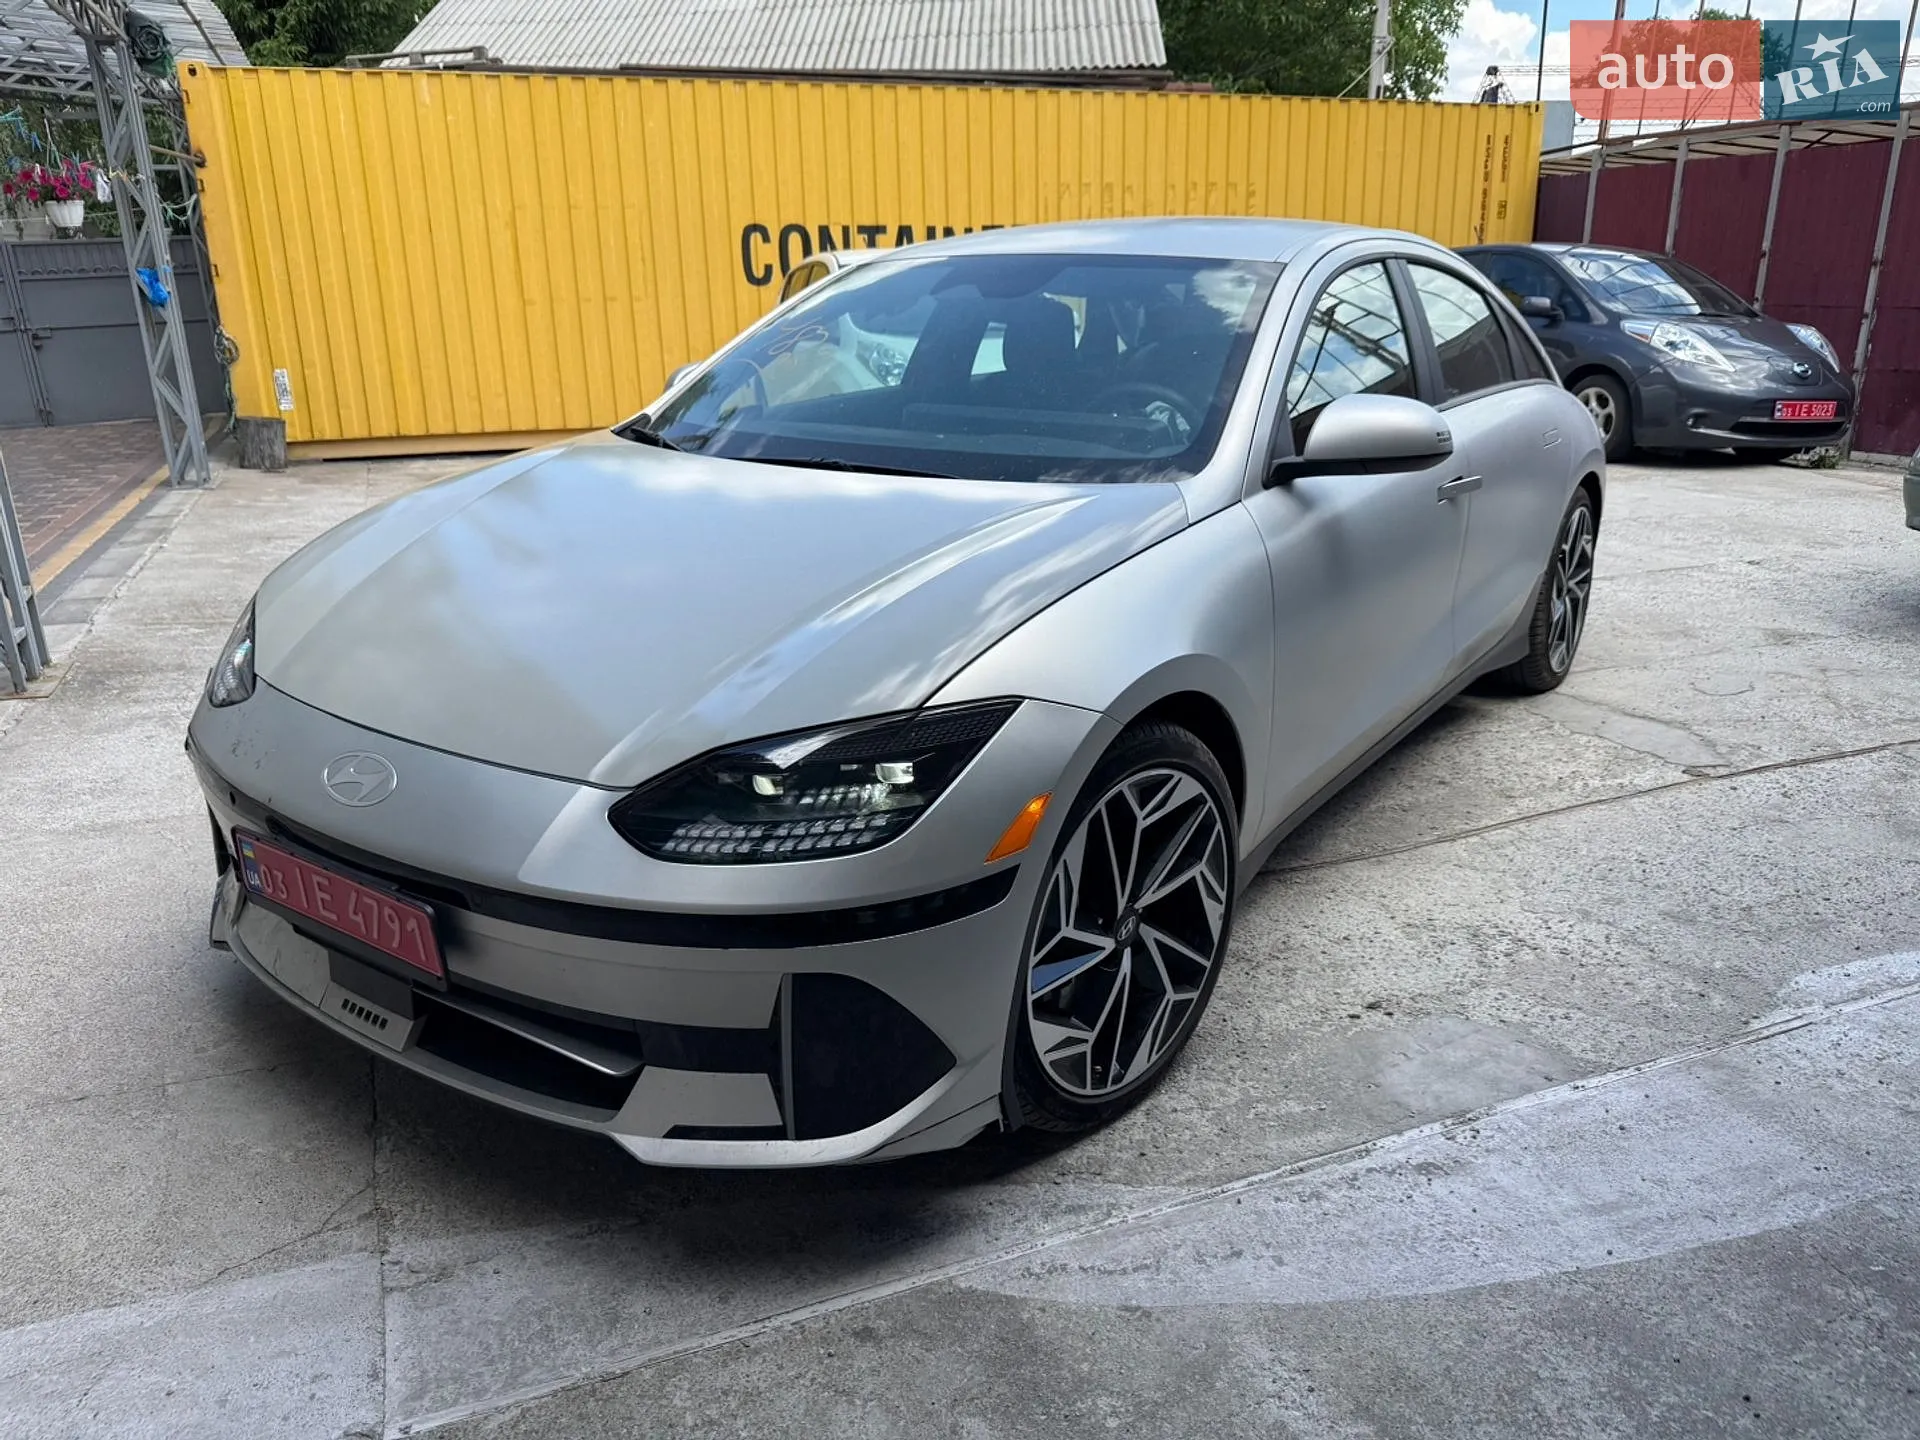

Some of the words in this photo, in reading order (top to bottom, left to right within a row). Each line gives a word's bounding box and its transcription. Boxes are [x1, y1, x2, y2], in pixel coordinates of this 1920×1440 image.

[1810, 403, 1834, 417] 5023
[246, 869, 262, 889] UA
[260, 863, 289, 900] 03
[295, 866, 339, 922] IE
[348, 889, 428, 962] 4791
